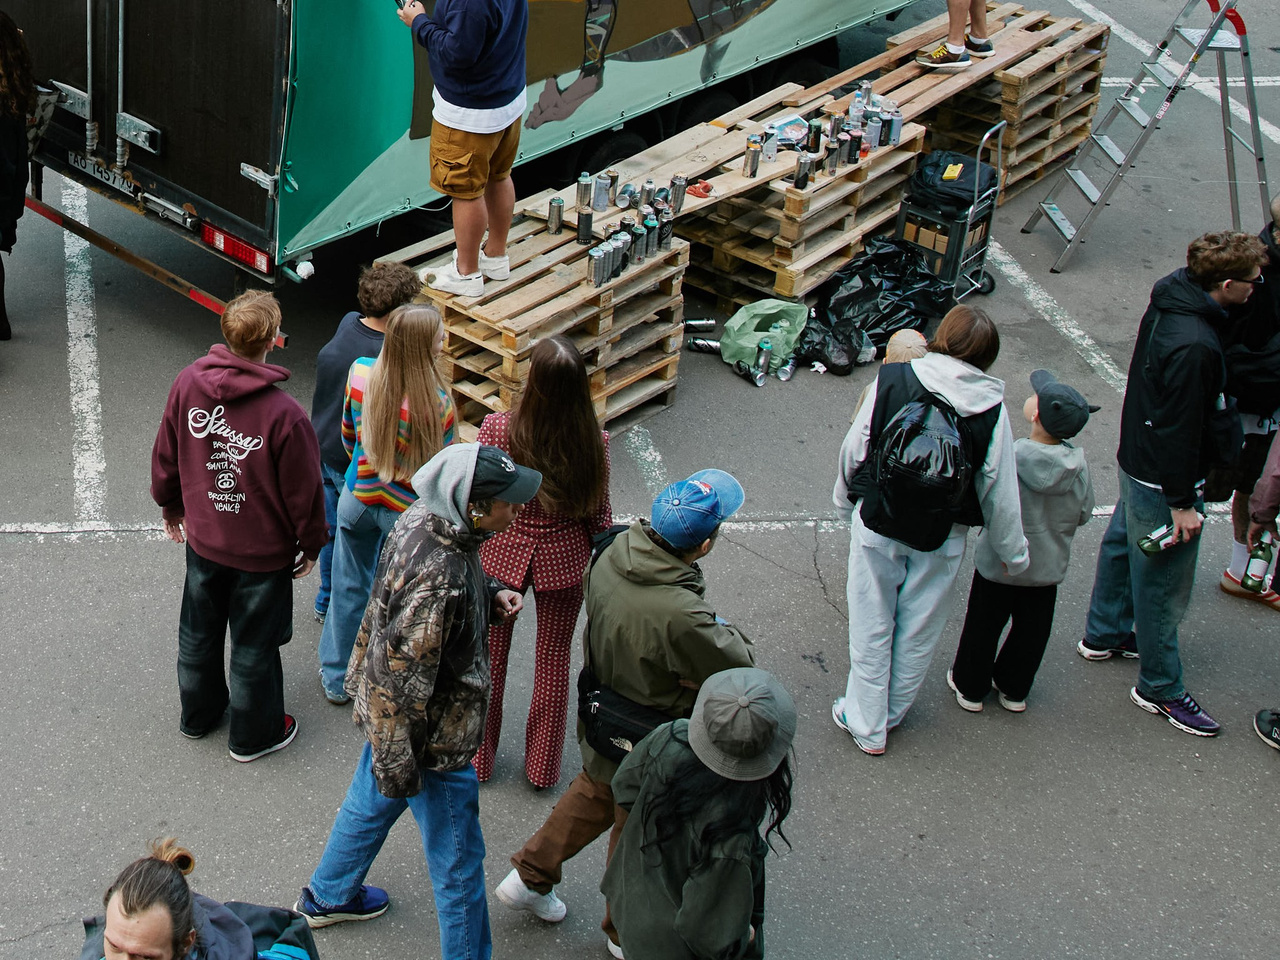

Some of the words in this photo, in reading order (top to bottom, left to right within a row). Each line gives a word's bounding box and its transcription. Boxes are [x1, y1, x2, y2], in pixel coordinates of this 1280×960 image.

[187, 405, 264, 459] Stüssy
[206, 461, 228, 471] SANTA
[207, 491, 246, 503] BROOKLYN
